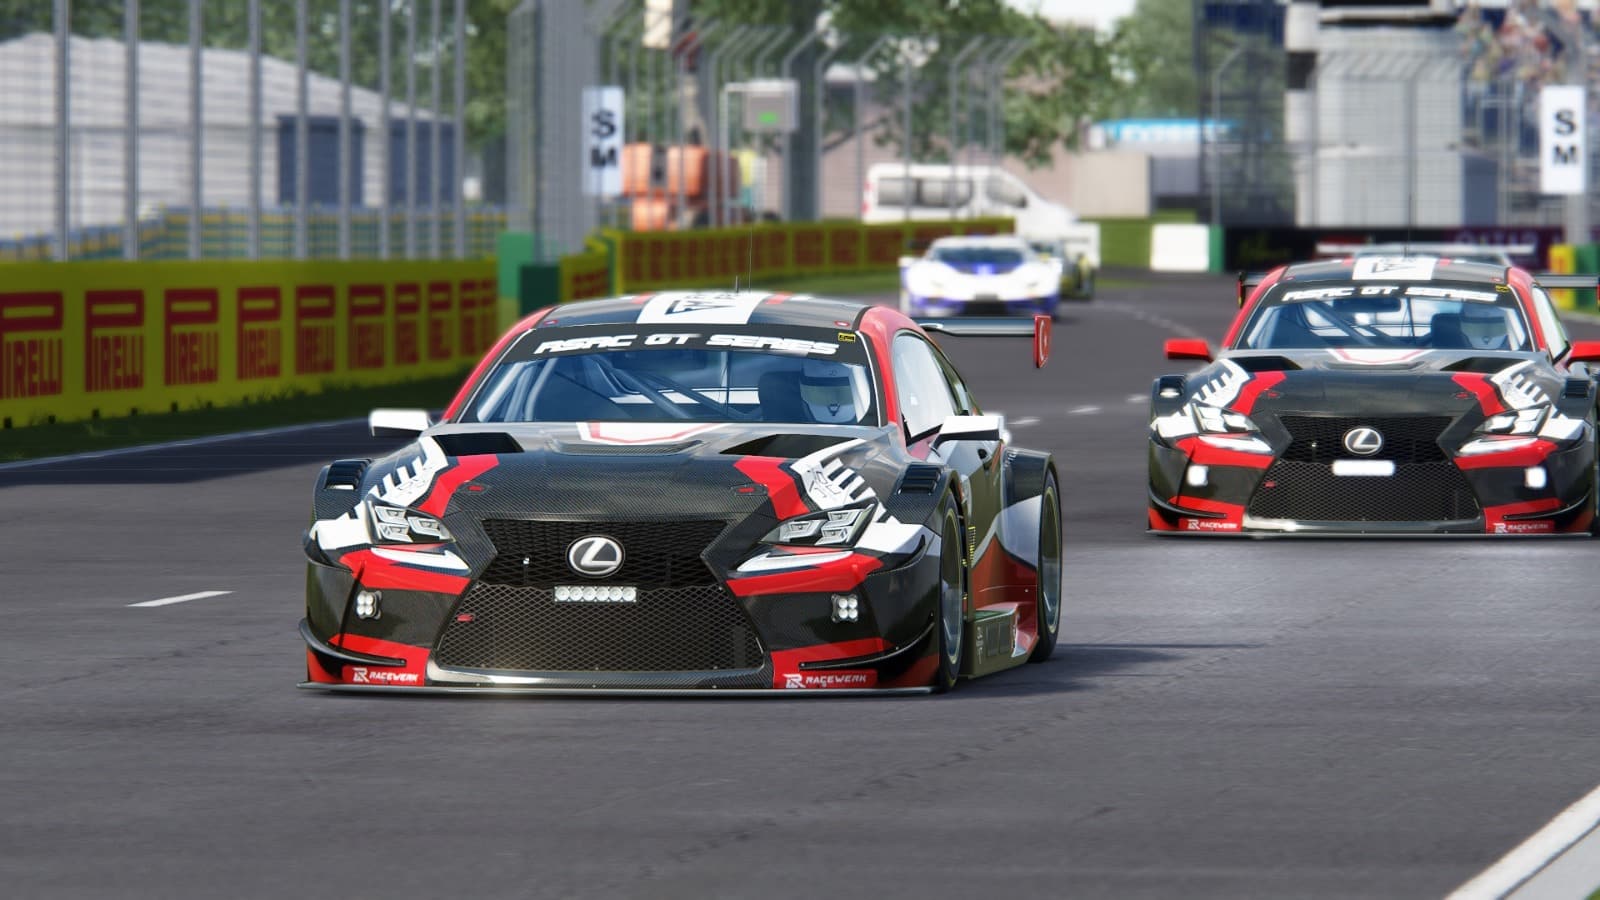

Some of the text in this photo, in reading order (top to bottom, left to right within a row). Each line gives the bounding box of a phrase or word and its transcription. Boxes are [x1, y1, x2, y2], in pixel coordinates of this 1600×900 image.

[1360, 286, 1400, 295] GT
[1404, 286, 1499, 302] SERIES
[85, 289, 145, 392] PIRELLI
[164, 288, 219, 386] PIRELLI
[644, 333, 703, 345] GT
[705, 334, 840, 355] SERIES
[369, 671, 419, 683] RACEWERK
[806, 675, 867, 684] RACEWERK
